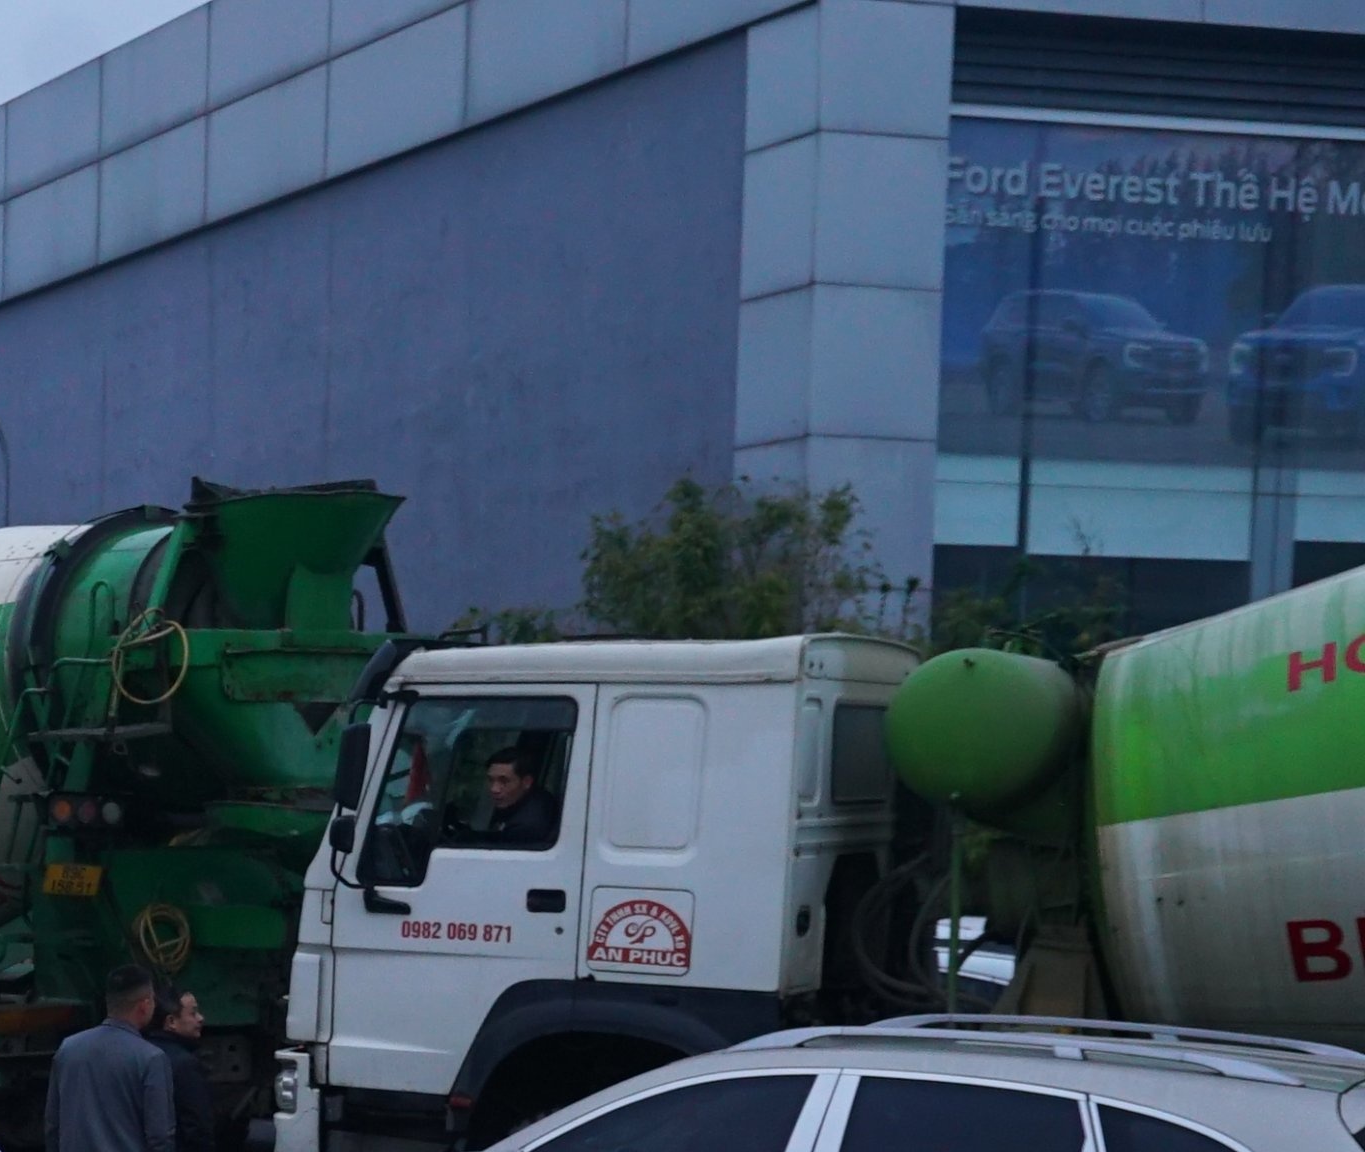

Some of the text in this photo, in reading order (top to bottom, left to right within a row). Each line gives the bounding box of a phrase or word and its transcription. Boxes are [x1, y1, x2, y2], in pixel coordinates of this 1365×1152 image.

[946, 158, 1028, 197] Ford
[1039, 161, 1180, 206] Everest
[1325, 180, 1365, 216] M
[401, 920, 512, 944] 0982 069 871
[1286, 917, 1365, 983] B
[592, 946, 623, 960] AN
